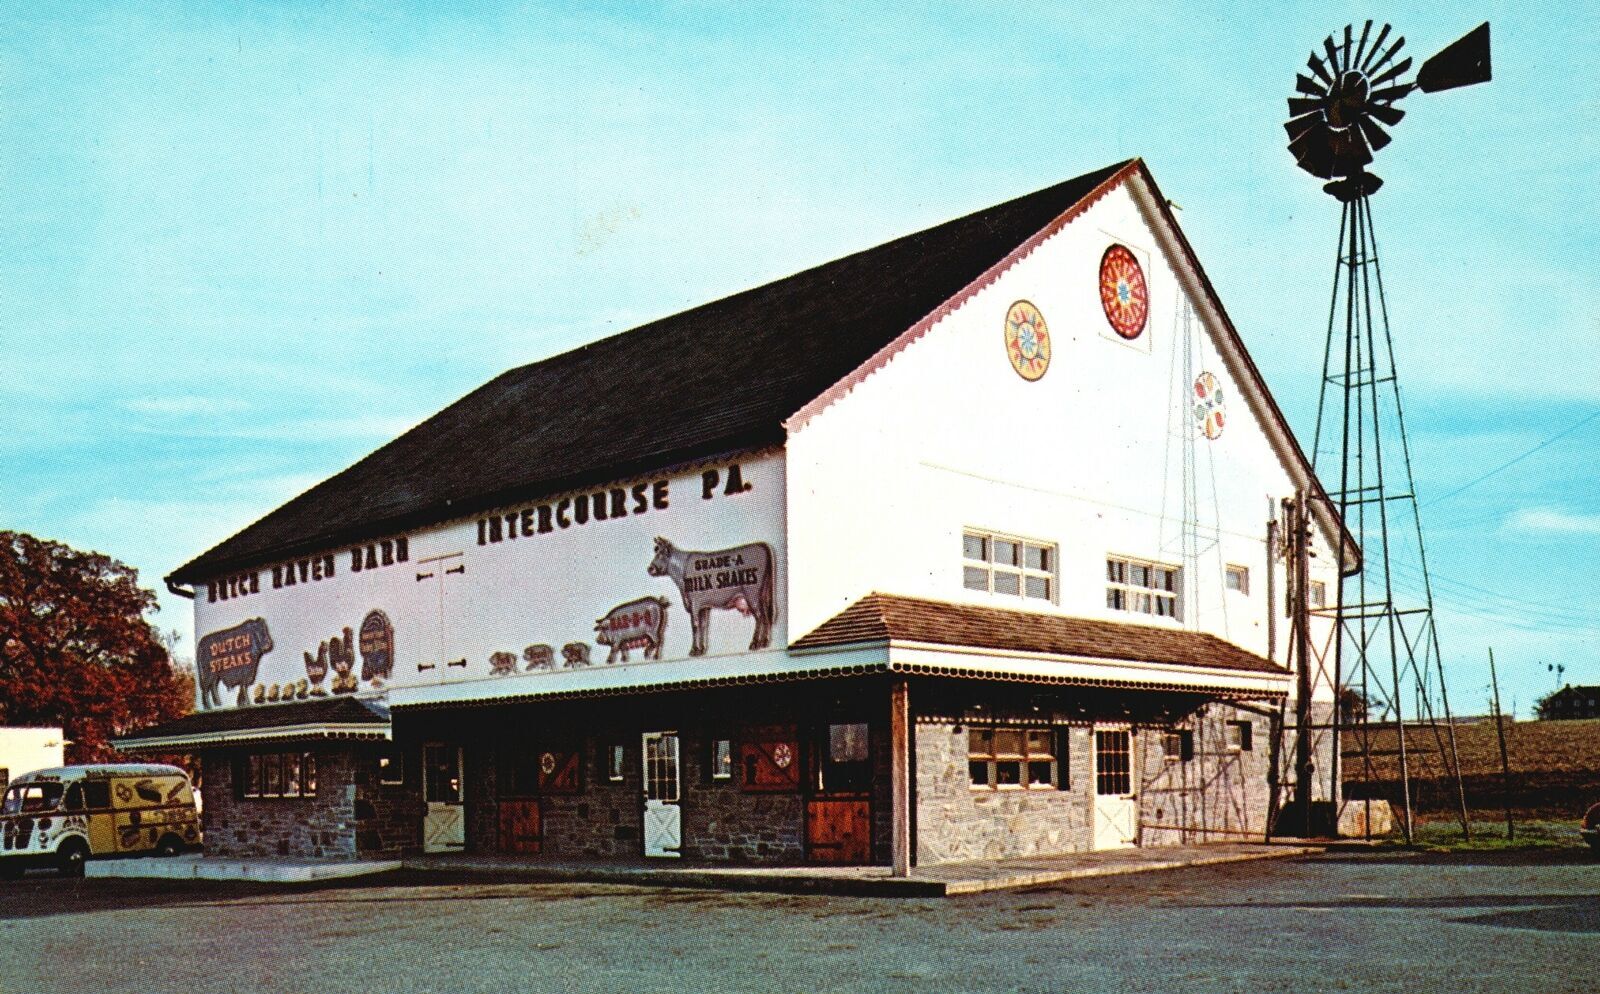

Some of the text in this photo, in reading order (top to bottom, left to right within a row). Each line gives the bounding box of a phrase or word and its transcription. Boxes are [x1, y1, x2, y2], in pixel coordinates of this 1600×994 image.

[477, 464, 752, 546] INTERCOURSE PA.
[694, 554, 744, 571] GRADE-A
[684, 567, 758, 592] MILK SHAKES
[209, 633, 251, 655] DUTCH
[209, 654, 252, 673] STEAKS
